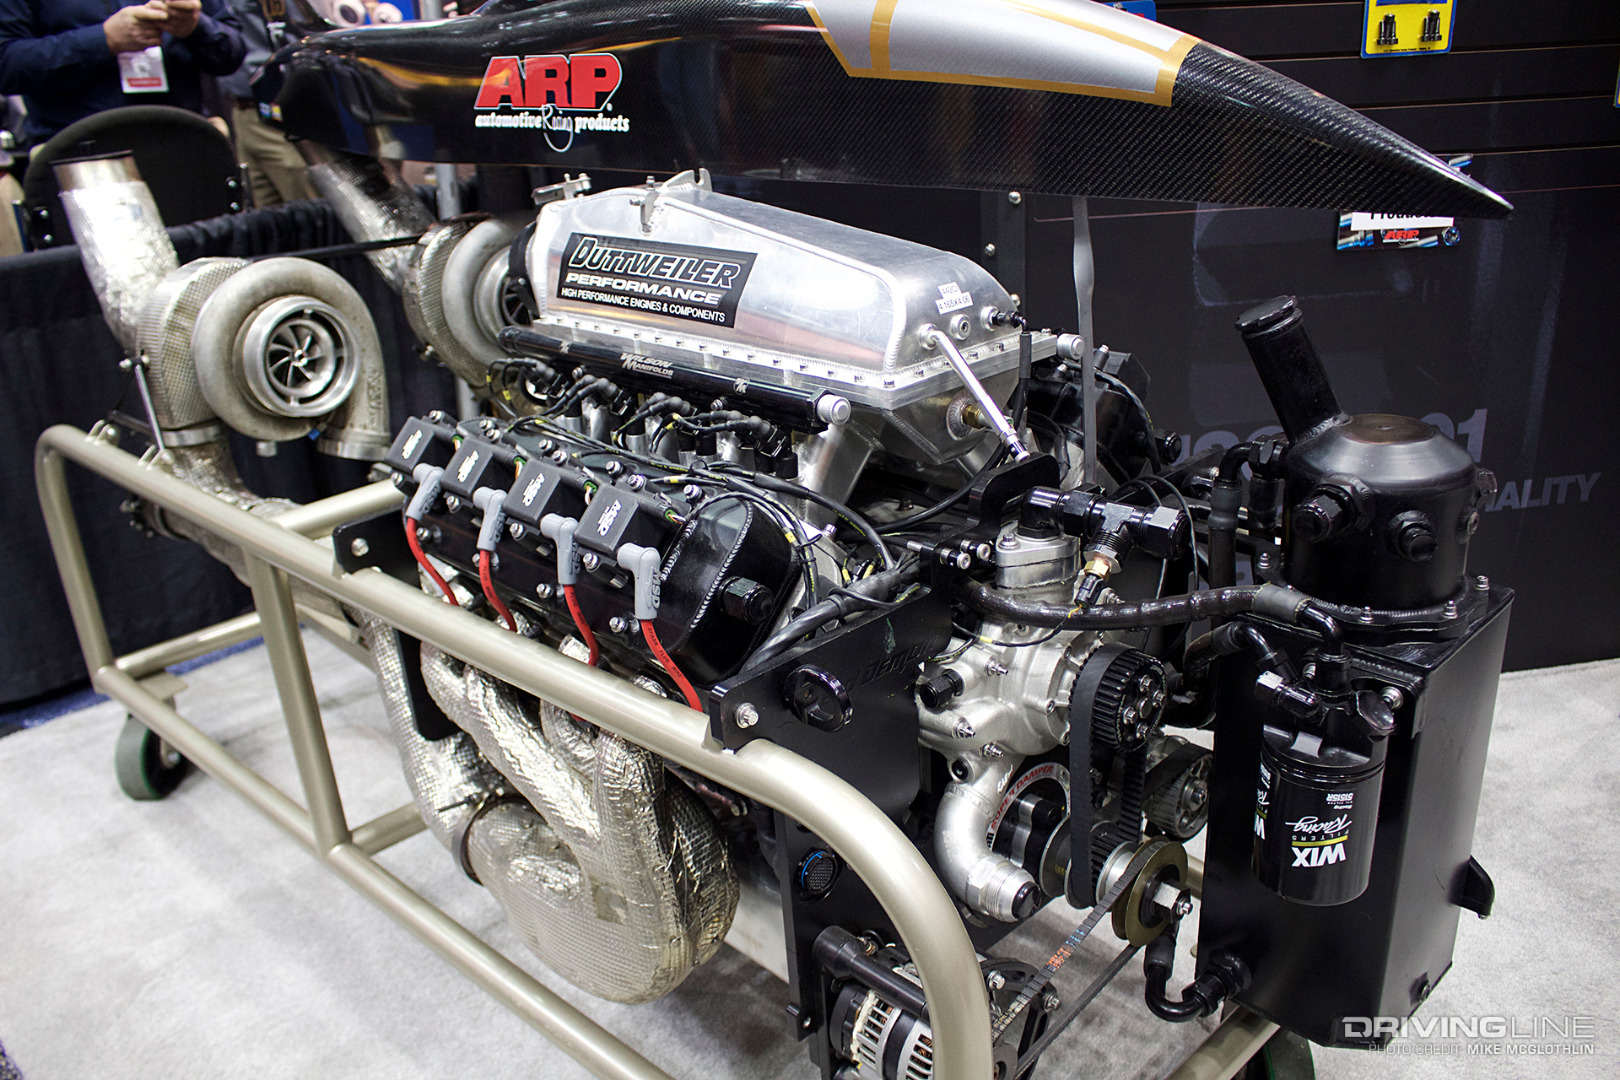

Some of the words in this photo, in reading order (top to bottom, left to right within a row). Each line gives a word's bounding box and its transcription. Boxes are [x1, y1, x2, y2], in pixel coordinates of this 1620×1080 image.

[474, 53, 622, 111] ARP
[475, 111, 542, 129] automotive
[574, 112, 630, 134] products
[1383, 230, 1420, 240] ARP
[568, 236, 741, 289] DUTTWEILER
[561, 287, 578, 298] HIGH
[577, 289, 630, 307] PERFORMANCE
[630, 297, 662, 313] ENGINES
[662, 302, 668, 312] &
[669, 304, 726, 322] COMPONENTS
[565, 272, 723, 306] PERFORMANCE
[620, 352, 675, 369] WILSON
[621, 358, 675, 376] MANIFOLDS
[1485, 472, 1601, 512] ALITY
[598, 499, 622, 537] MSD
[651, 566, 662, 609] MSD
[648, 627, 658, 646] SPARK
[659, 650, 670, 664] PLUG
[990, 789, 1015, 831] SUPER
[1016, 765, 1054, 790] DAMPER
[1285, 813, 1353, 834] Racing
[1291, 828, 1350, 841] FILTERS
[1291, 842, 1347, 868] WIX
